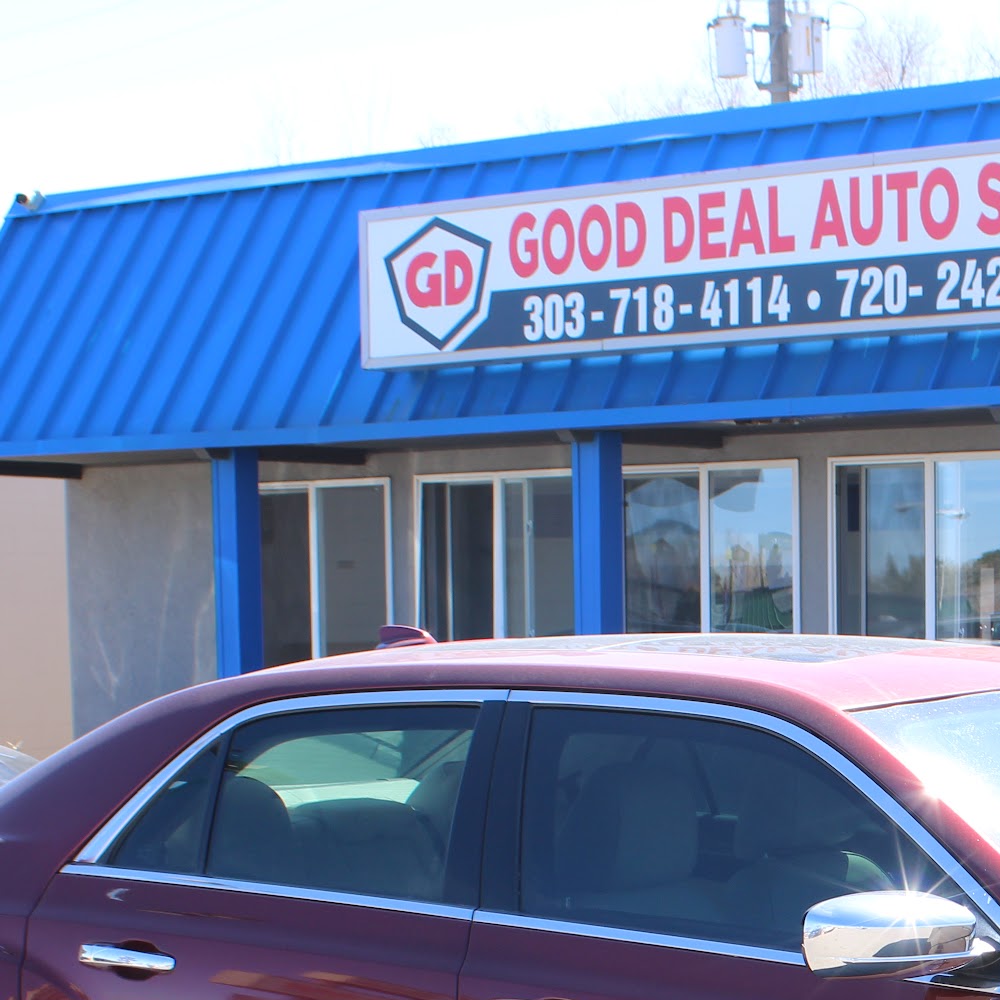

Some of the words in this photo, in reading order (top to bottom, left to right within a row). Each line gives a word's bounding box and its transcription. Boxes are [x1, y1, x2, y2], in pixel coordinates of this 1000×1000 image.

[508, 201, 647, 278] GOOD
[663, 185, 796, 263] DEAL
[810, 167, 960, 250] AUTO
[405, 249, 473, 308] GD
